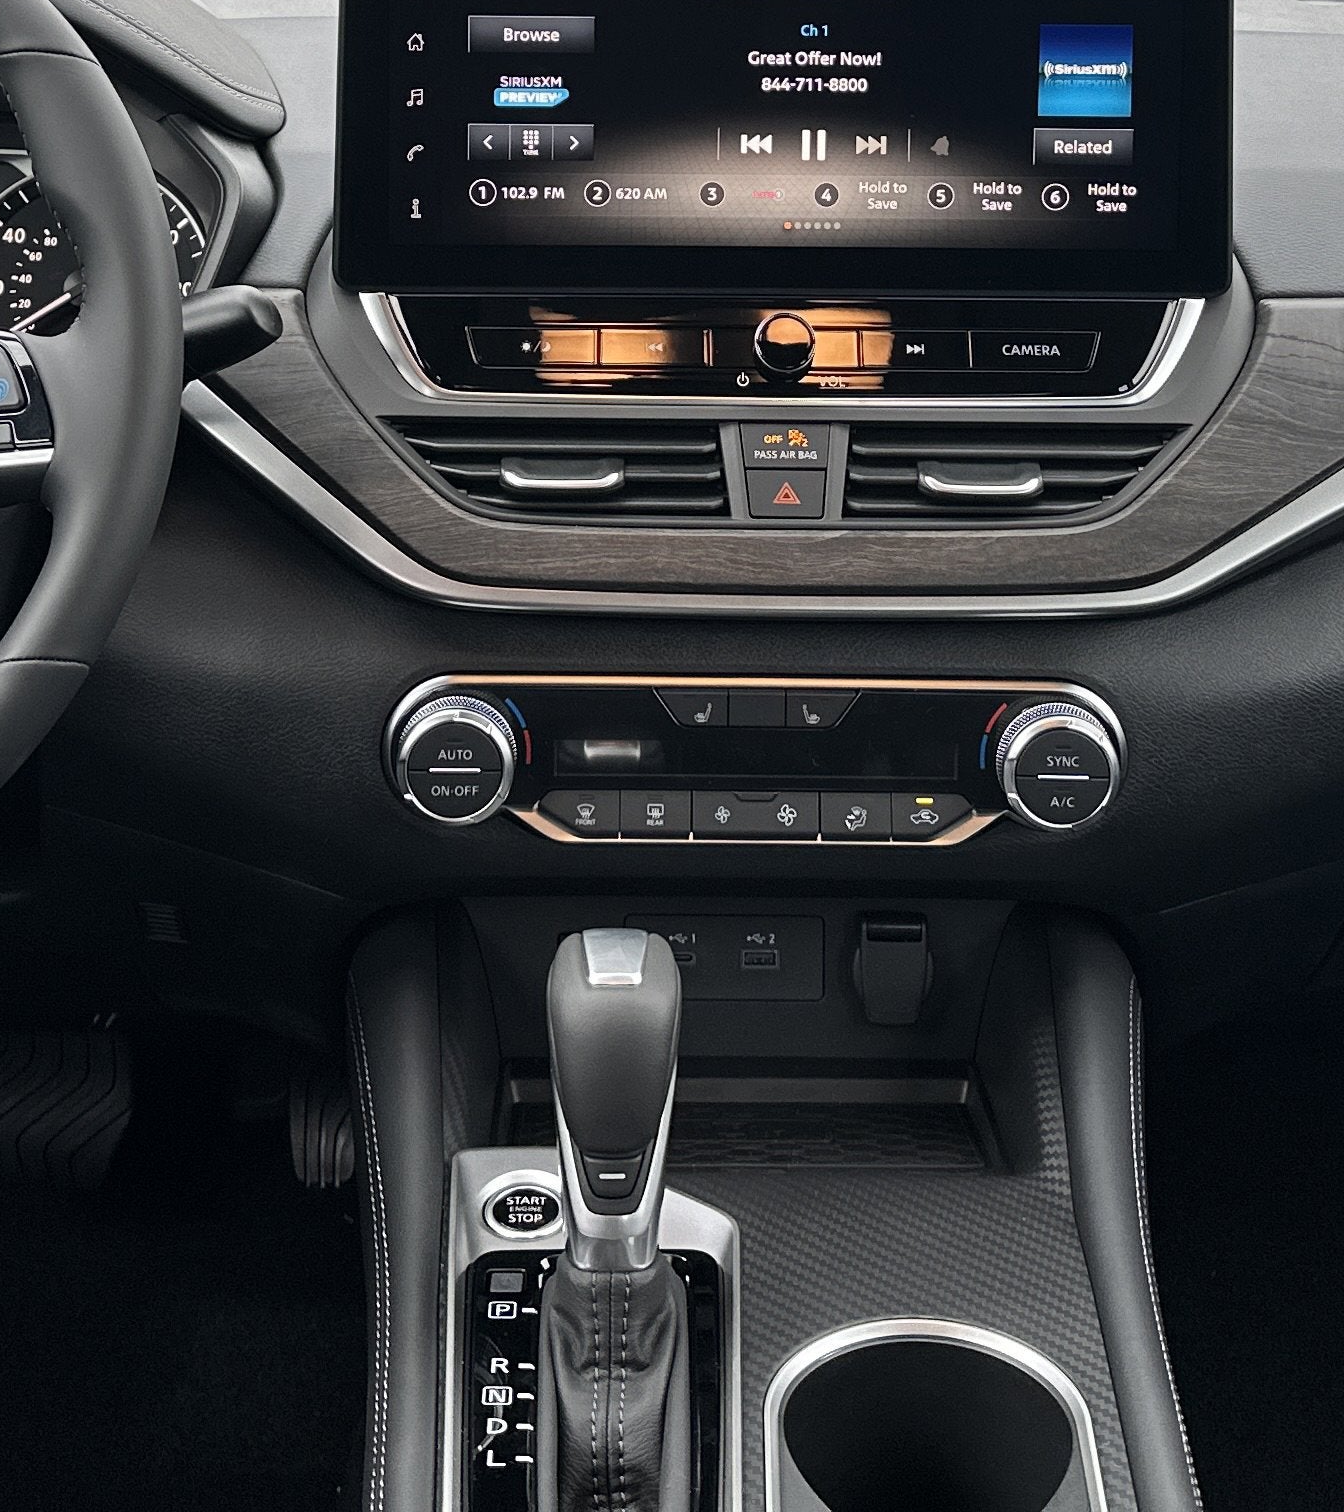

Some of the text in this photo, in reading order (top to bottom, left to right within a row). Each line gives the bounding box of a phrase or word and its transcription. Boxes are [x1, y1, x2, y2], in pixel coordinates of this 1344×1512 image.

[503, 28, 560, 42] Browse
[800, 24, 829, 37] Ch 1
[747, 51, 882, 66] Great Offer Now!
[500, 76, 562, 88] SIRIUSXM
[761, 77, 868, 92] 844-711-8800
[500, 92, 560, 103] PREVIEW
[1054, 140, 1112, 154] Related
[858, 181, 888, 194] Hold
[893, 182, 908, 194] to
[973, 182, 1004, 195] Hold
[1007, 184, 1022, 196] to
[1087, 183, 1119, 196] Hold
[1122, 185, 1137, 197] to
[501, 188, 538, 200] 102.9
[544, 188, 565, 200] FM
[615, 188, 641, 200] 620
[643, 188, 668, 200] AM
[867, 198, 898, 210] Save
[981, 199, 1013, 211] Save
[1096, 200, 1127, 212] Save
[2, 228, 26, 244] 40
[43, 236, 58, 247] 80
[29, 251, 43, 262] 60
[18, 274, 32, 284] 40
[18, 298, 31, 309] 20
[1001, 343, 1062, 357] CAMERA
[818, 376, 846, 387] VOL
[763, 434, 784, 444] OFF
[754, 450, 818, 460] PASS AIR BAG
[437, 749, 473, 761] AUTO
[1046, 756, 1080, 768] SYNC
[1050, 796, 1076, 809] A/C
[574, 818, 596, 826] FRONT
[768, 933, 776, 944] 2
[506, 1196, 547, 1206] START
[508, 1213, 544, 1223] STOP
[495, 1305, 511, 1316] P
[490, 1358, 510, 1373] R
[488, 1389, 507, 1402] N
[487, 1419, 508, 1435] D
[486, 1450, 506, 1467] L
